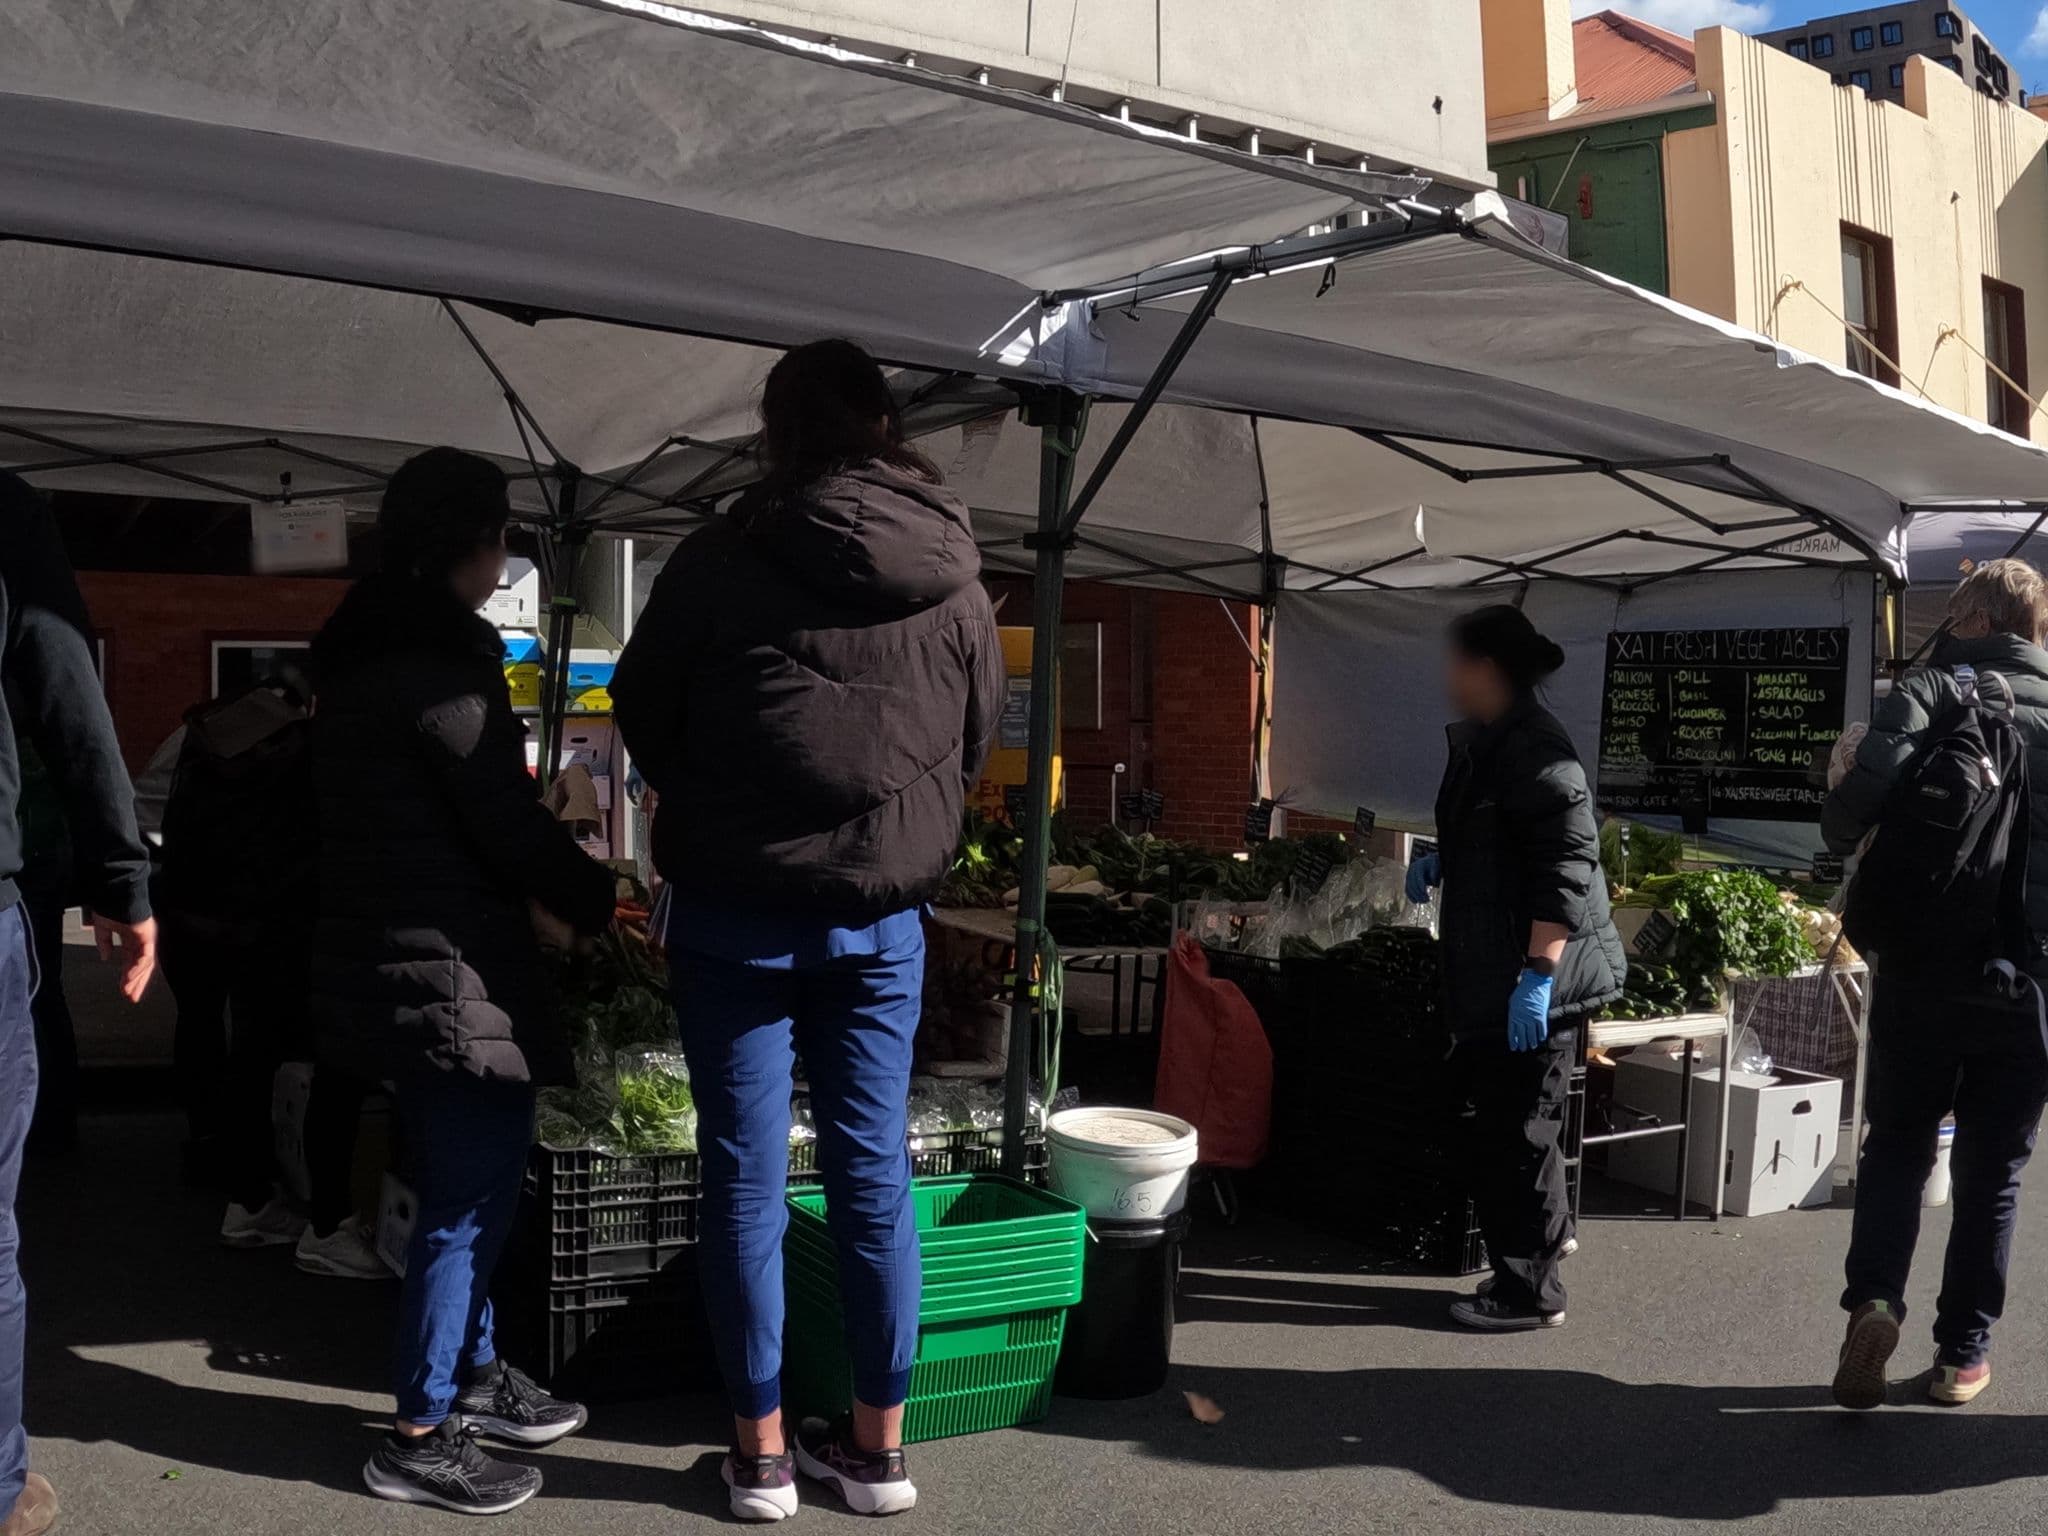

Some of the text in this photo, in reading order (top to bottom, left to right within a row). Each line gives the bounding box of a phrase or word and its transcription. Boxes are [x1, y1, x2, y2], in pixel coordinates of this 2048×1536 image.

[1663, 630, 1718, 660] FRESH
[1612, 671, 1652, 685] DAIKON
[1678, 670, 1711, 684] DILL
[1610, 688, 1656, 701] CHINESE
[1679, 689, 1710, 701] BASIL
[1756, 688, 1826, 703] ASPARAGUS
[1611, 700, 1661, 713] BROCCOLI
[1759, 705, 1804, 719] SALAD
[1611, 716, 1646, 728] SHISO
[1678, 726, 1724, 740] ROCKET
[1756, 728, 1797, 740] ZUCCHINI
[1675, 746, 1737, 762] BROCCOLINI
[1753, 748, 1813, 765] TONG HO
